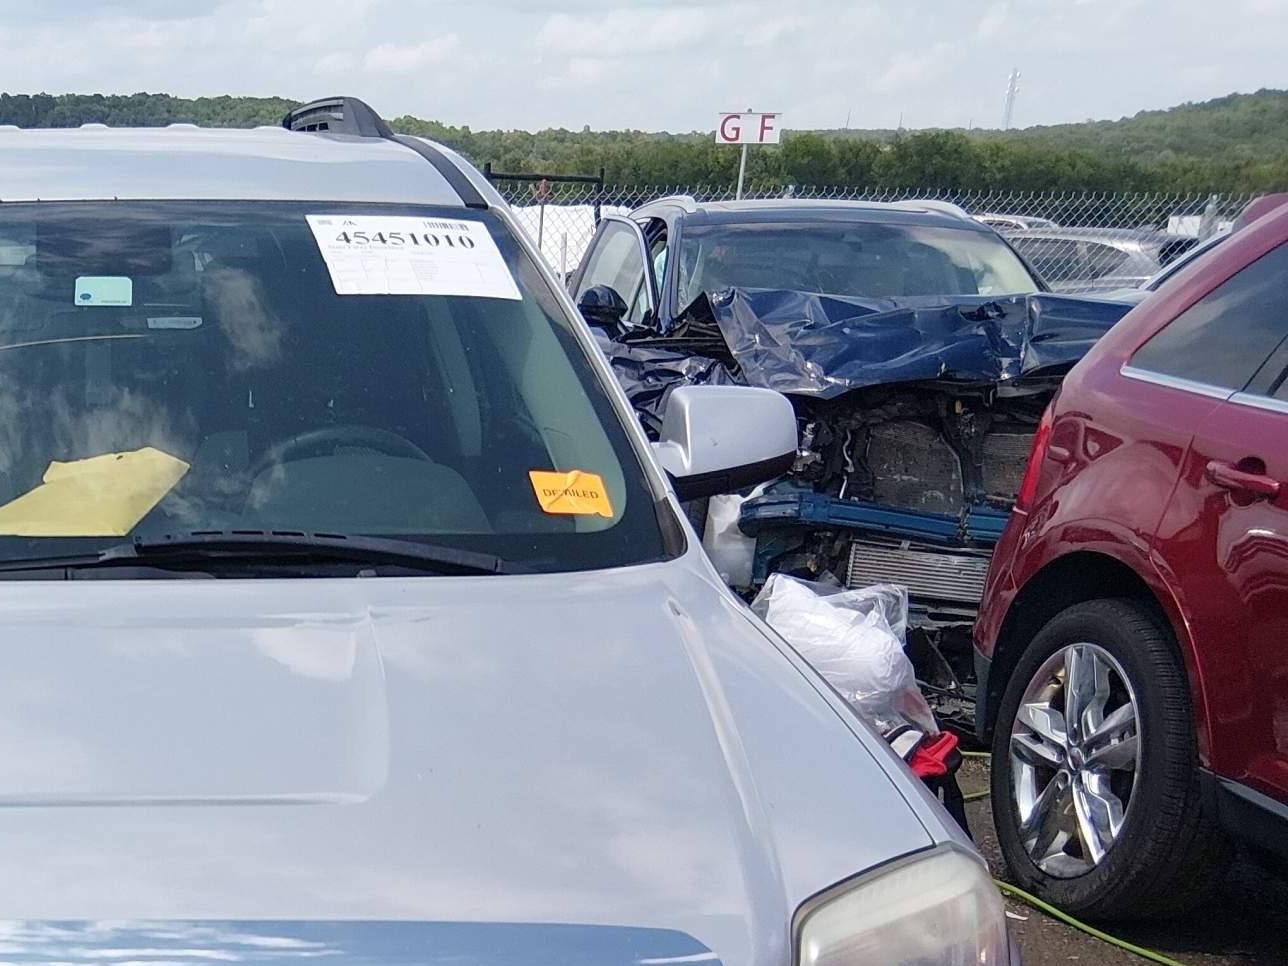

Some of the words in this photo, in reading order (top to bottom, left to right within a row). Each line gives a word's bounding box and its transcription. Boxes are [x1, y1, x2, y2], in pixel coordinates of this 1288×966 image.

[720, 114, 741, 142] G
[758, 114, 776, 142] F
[335, 231, 475, 249] 45451010
[542, 488, 599, 499] DEAILED
